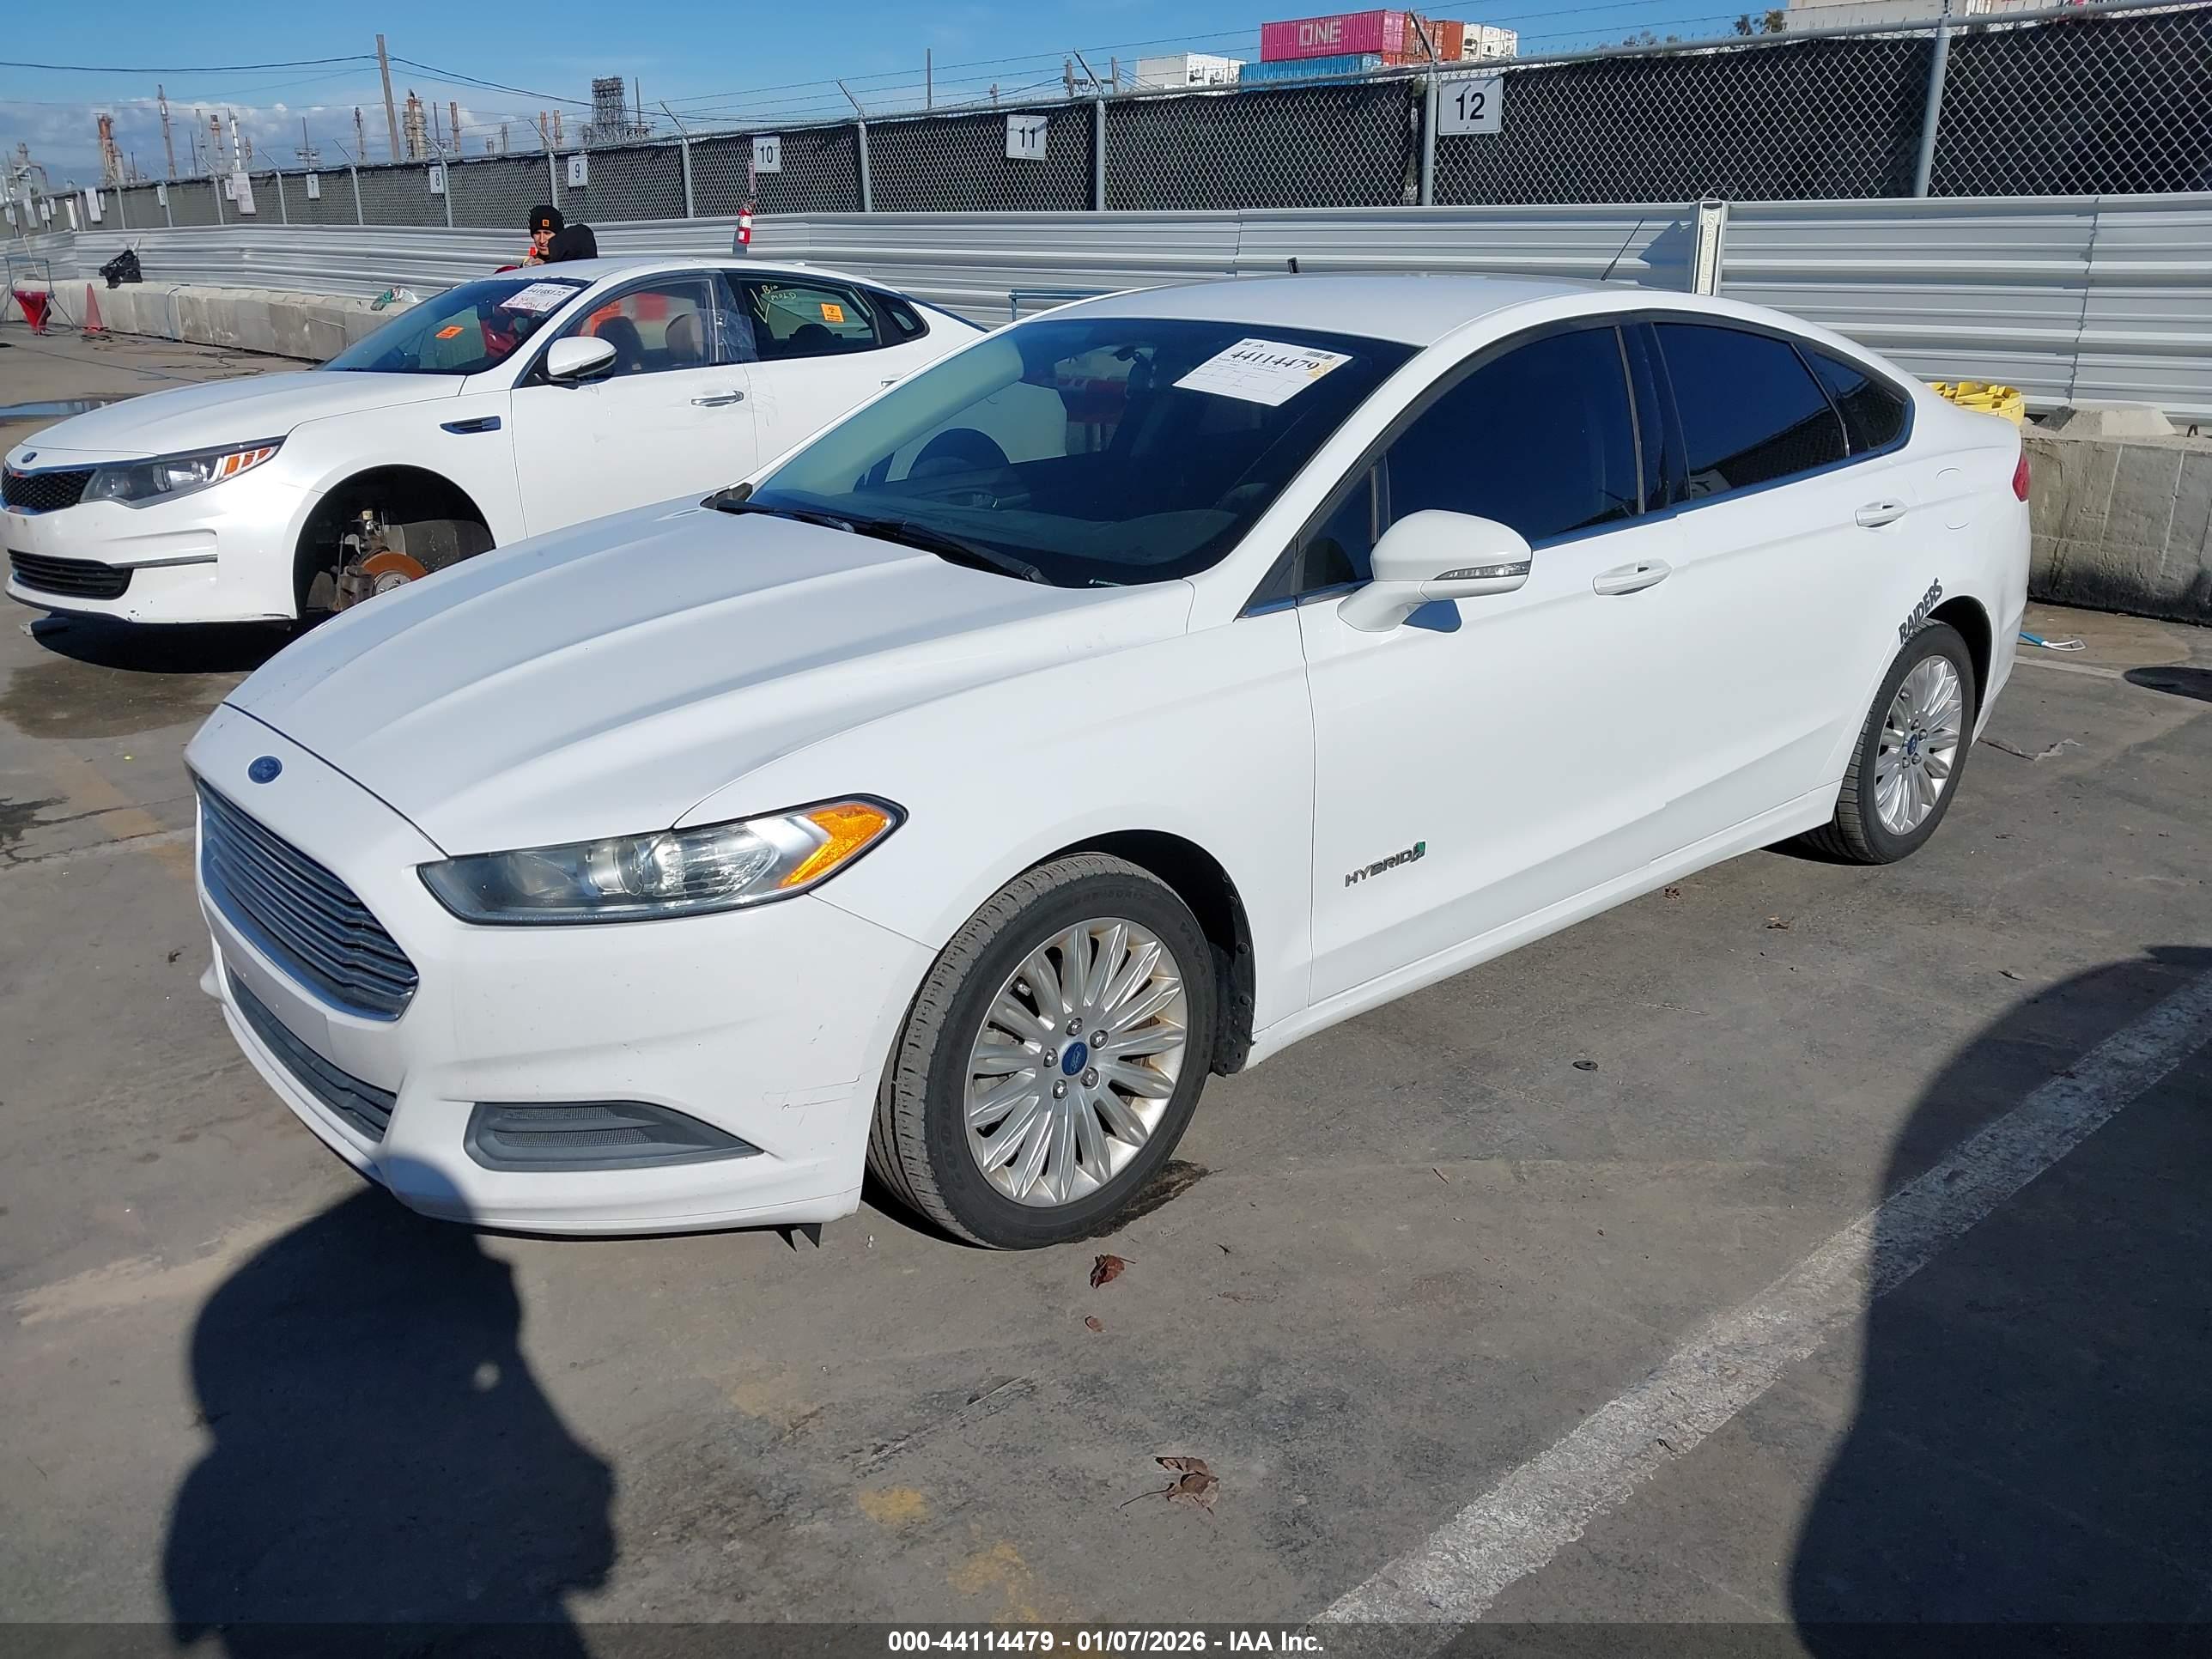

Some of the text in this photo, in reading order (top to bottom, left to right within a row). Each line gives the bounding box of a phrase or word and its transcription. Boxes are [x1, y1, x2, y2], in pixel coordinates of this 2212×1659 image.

[1298, 19, 1341, 46] ONE
[1455, 92, 1486, 121] 12
[1018, 125, 1036, 149] 11
[759, 144, 774, 164] 10
[435, 172, 441, 187] 8
[574, 163, 580, 179] 9
[1699, 212, 1716, 295] SPILL
[1230, 349, 1320, 371] 44114479
[1898, 577, 1943, 645] RAIDERS
[1345, 848, 1413, 887] HYBRID
